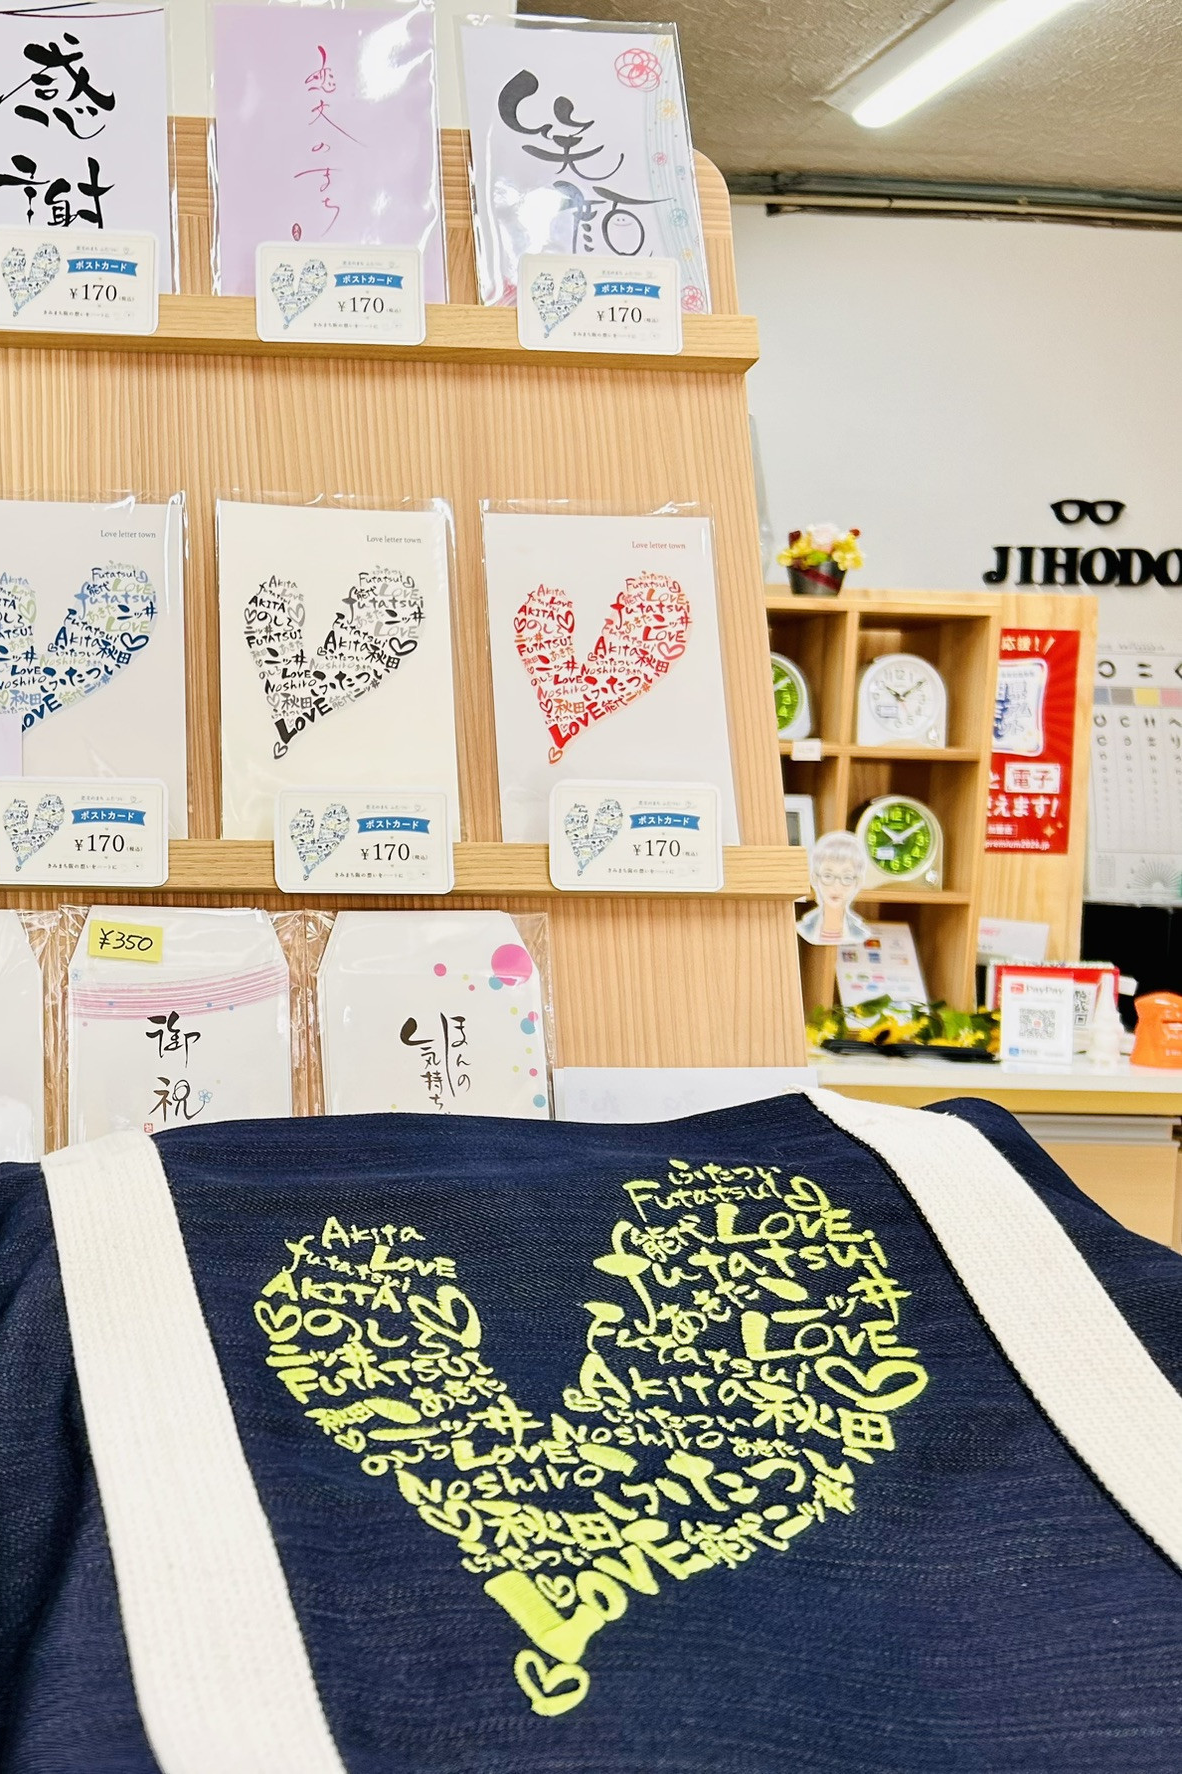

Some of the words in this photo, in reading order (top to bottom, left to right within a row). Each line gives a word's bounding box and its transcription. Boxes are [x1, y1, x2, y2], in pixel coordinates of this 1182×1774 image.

[498, 69, 676, 258] 笑顔
[75, 261, 127, 271] ポストカード
[342, 275, 393, 285] ポストカード
[69, 284, 117, 301] ¥170
[601, 285, 651, 294] ポストカード
[338, 297, 384, 313] ¥170
[596, 306, 642, 323] ¥170
[100, 530, 117, 538] Love
[119, 530, 136, 538] letter
[138, 531, 156, 539] town
[366, 535, 383, 543] Love
[632, 541, 648, 549] Love
[248, 596, 286, 612] AKITA
[518, 605, 555, 621] AKITA
[55, 626, 101, 646] Akita
[275, 697, 333, 744] LOVE
[549, 701, 606, 749] LOVE
[1012, 769, 1053, 790] 電子
[80, 811, 135, 821] ポストカード
[365, 819, 419, 829] ポストカード
[638, 816, 690, 826] ポストカード
[75, 835, 125, 852] ¥170
[361, 843, 410, 861] ¥170
[633, 840, 680, 857] ¥170
[99, 929, 154, 952] ¥350
[1026, 985, 1064, 996] PayPay
[440, 1012, 471, 1097] ほんの
[145, 1010, 206, 1124] 御祝
[400, 1017, 450, 1115] 気持ち
[716, 1203, 865, 1243] LOVE
[321, 1216, 426, 1249] Akita
[370, 1244, 457, 1278] LOVE
[262, 1271, 402, 1313] AKITA
[740, 1310, 919, 1361] LOVE
[579, 1352, 766, 1406] Akita
[484, 1518, 713, 1663] LOVE
